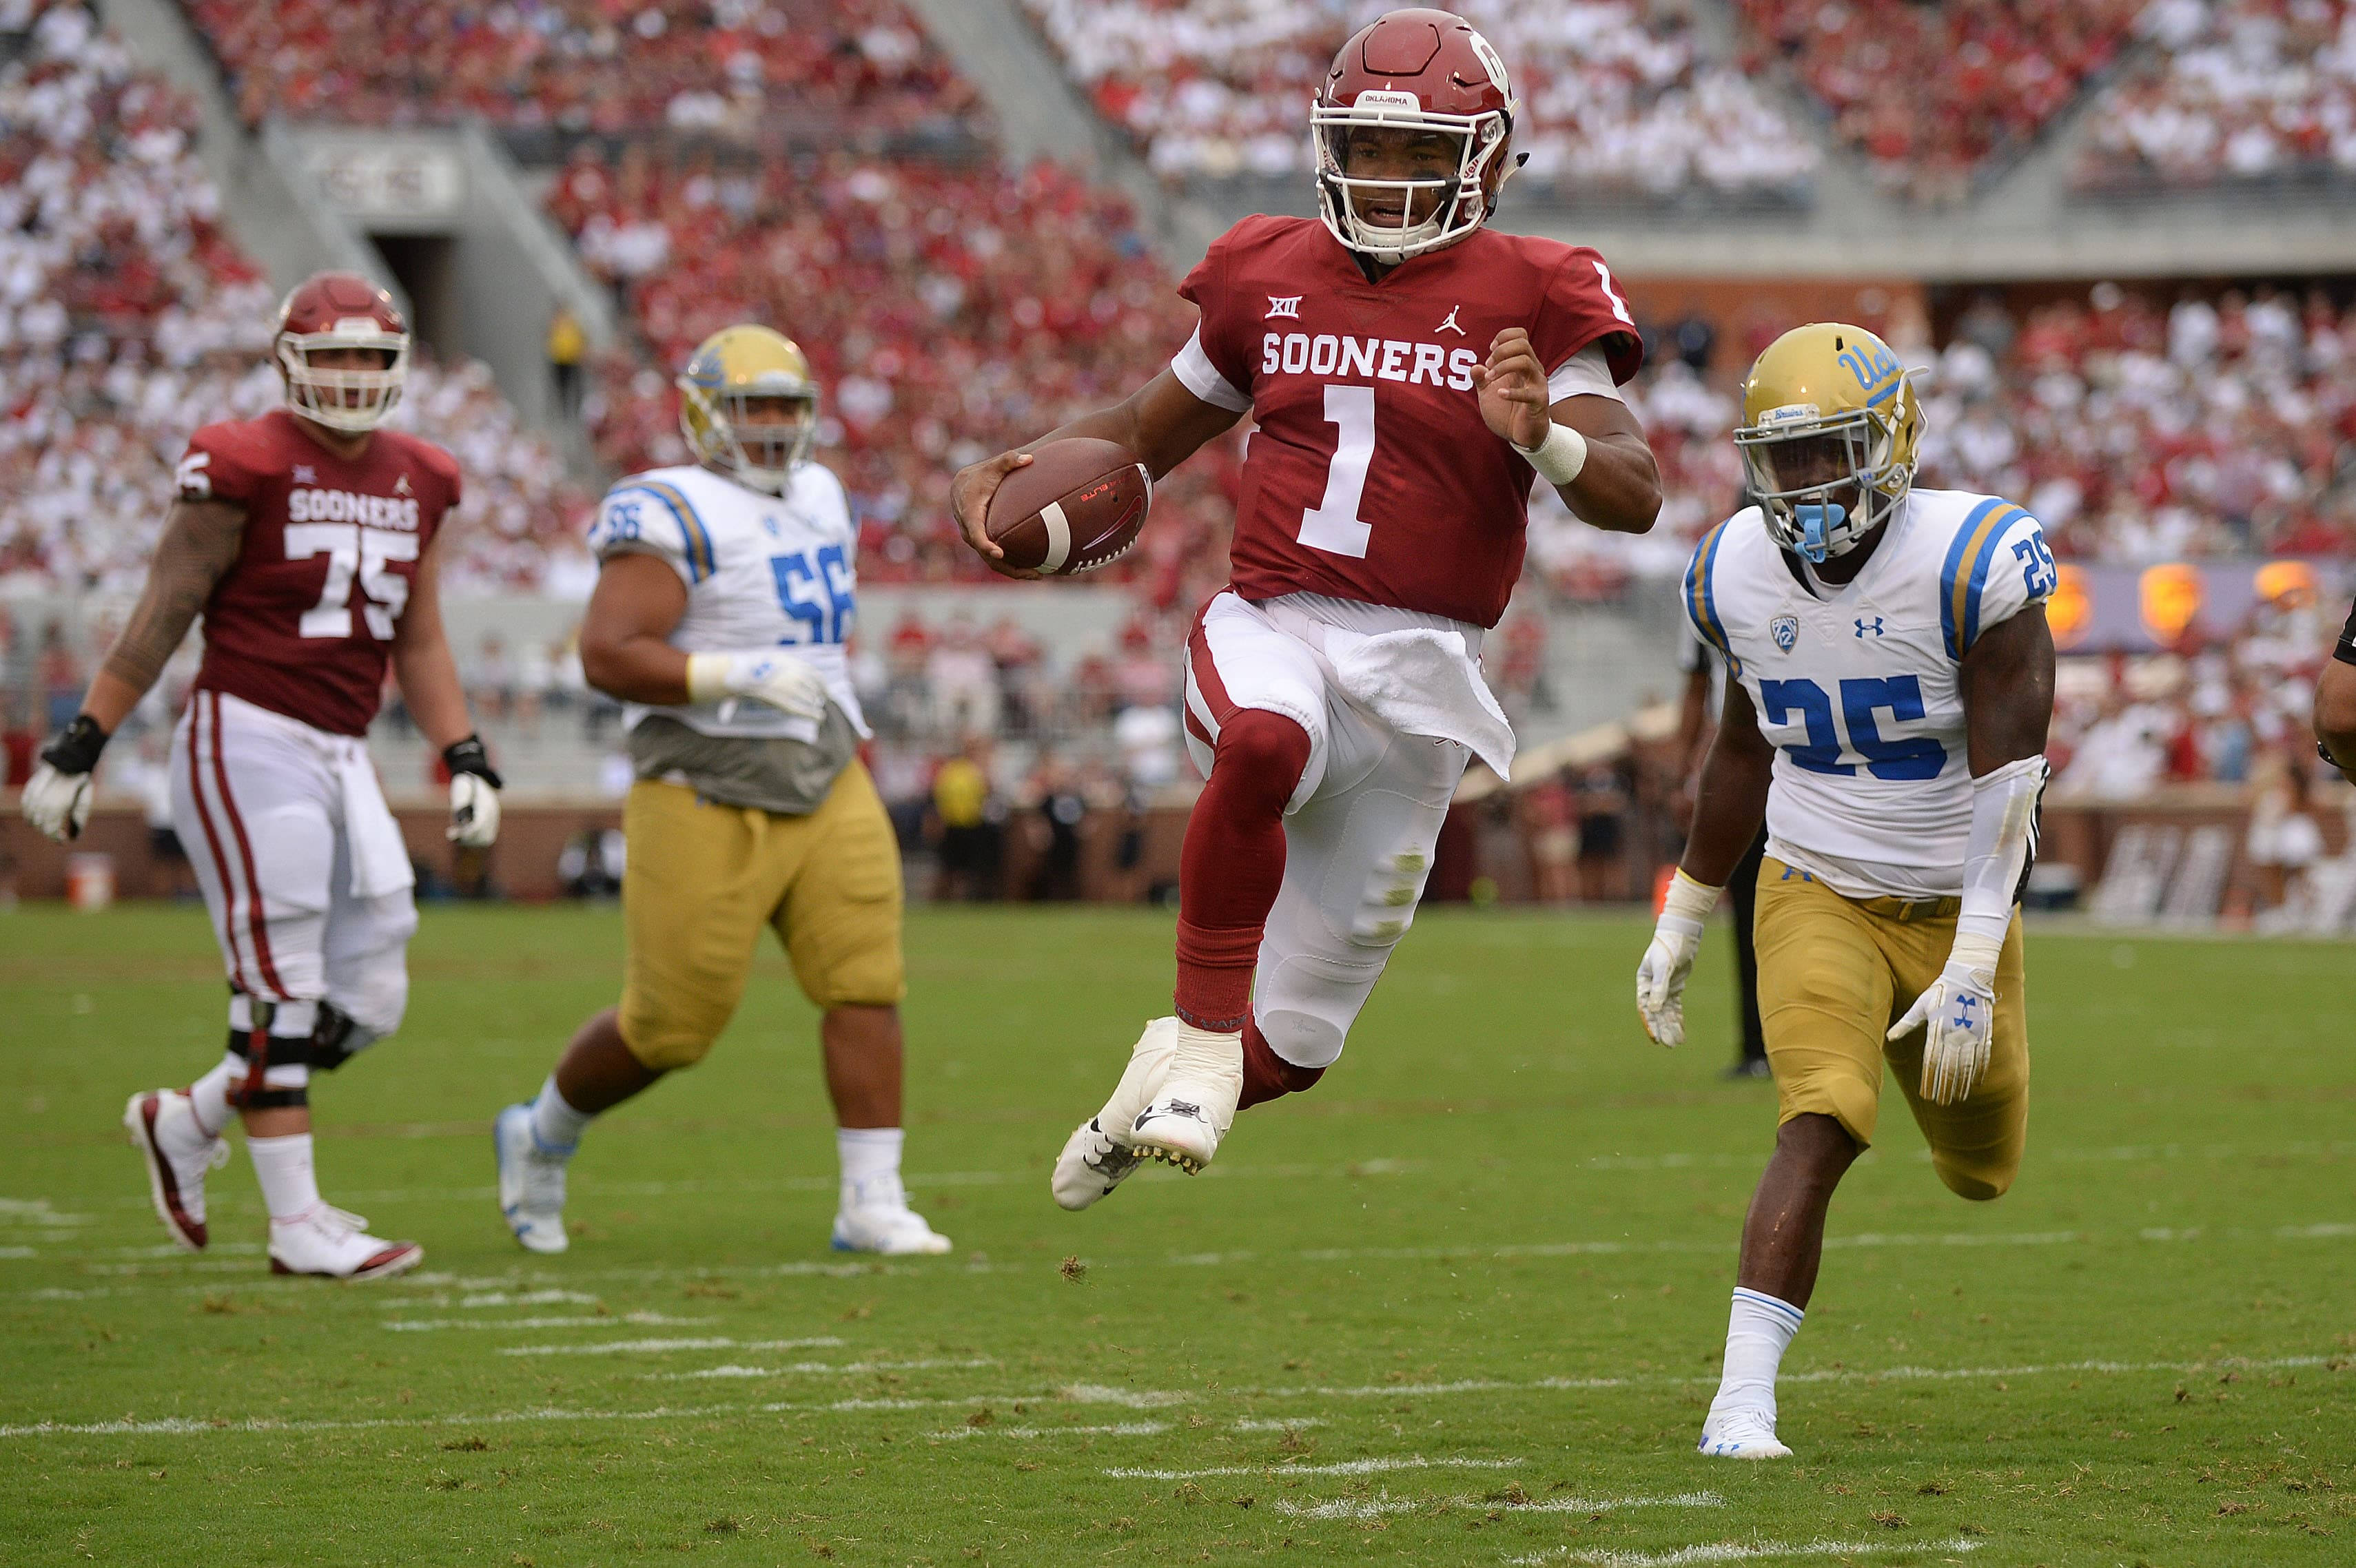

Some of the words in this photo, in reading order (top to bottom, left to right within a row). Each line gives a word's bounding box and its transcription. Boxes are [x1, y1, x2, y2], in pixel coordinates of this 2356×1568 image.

[1365, 95, 1408, 105] OKLAHOMA
[1264, 296, 1303, 319] XII
[1262, 333, 1477, 391] SOONERS
[1296, 384, 1375, 559] 1
[288, 488, 420, 532] SOONERS
[283, 522, 420, 641] 75
[770, 546, 853, 644] 56
[2011, 529, 2057, 599] 25
[1759, 674, 1948, 781] 25
